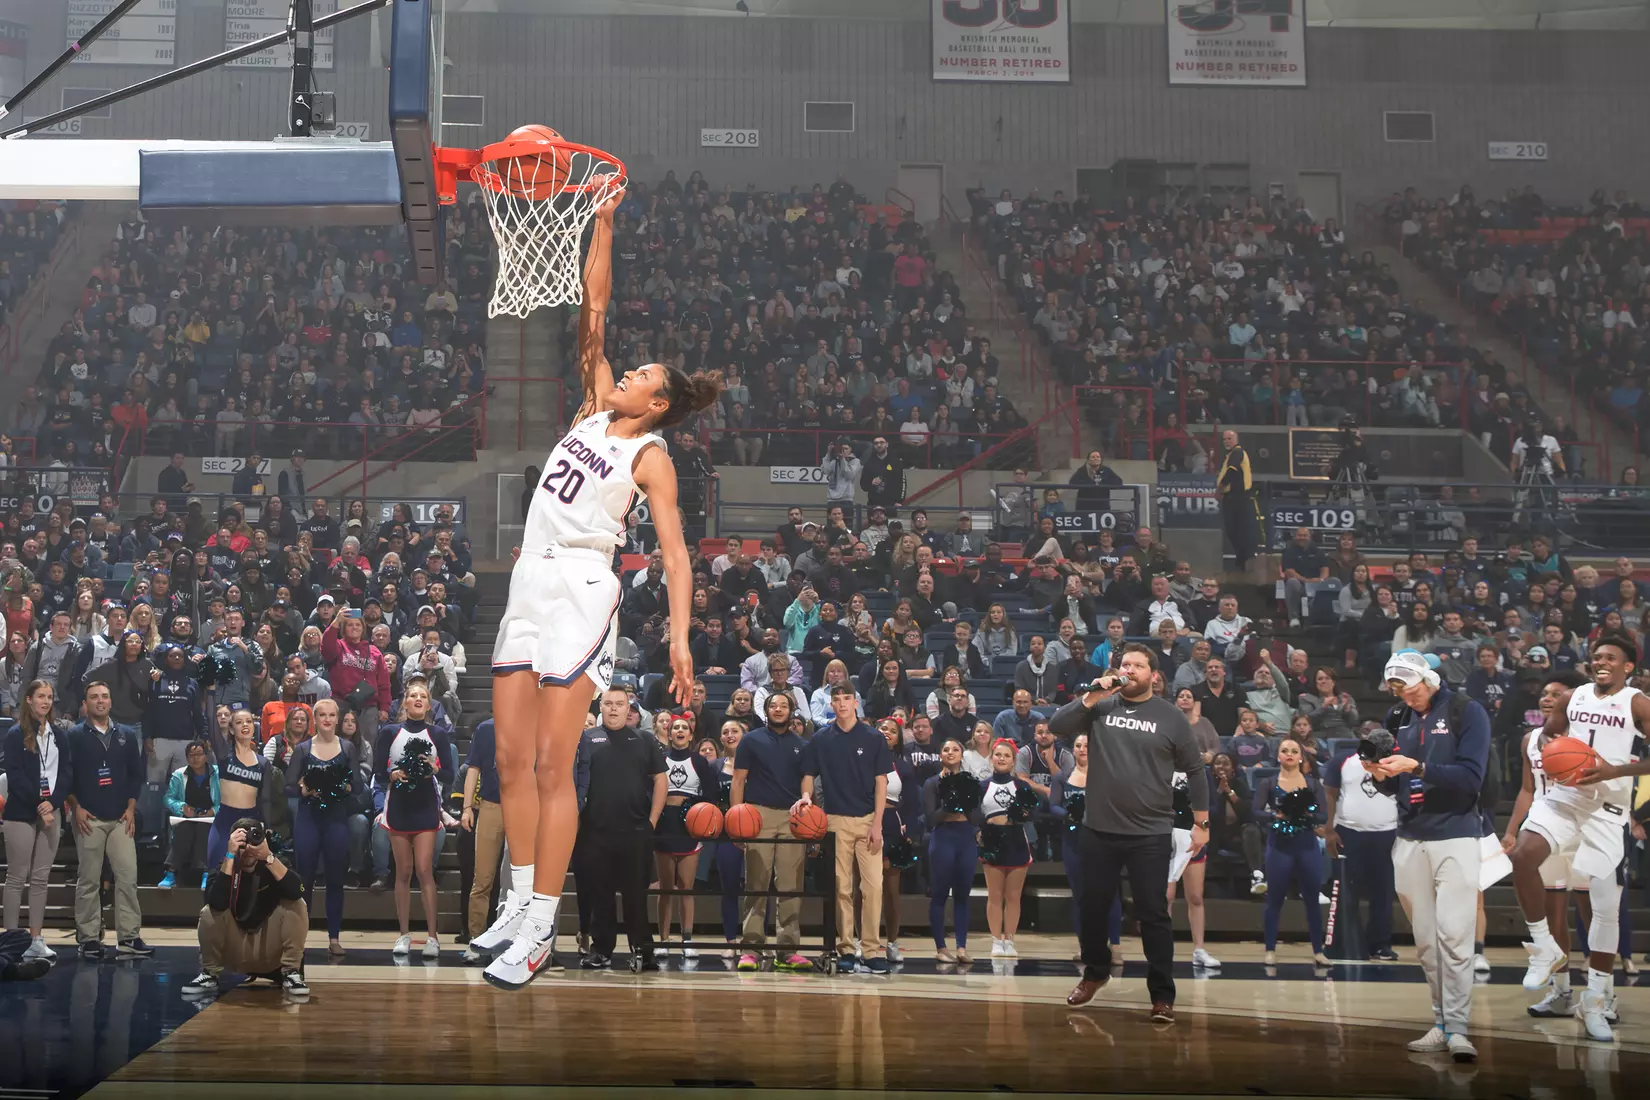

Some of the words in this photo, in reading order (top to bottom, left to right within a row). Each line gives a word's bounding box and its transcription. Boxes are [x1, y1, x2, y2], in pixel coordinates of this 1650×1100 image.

[69, 4, 116, 12] RIZZOTT
[227, 7, 265, 16] MOORE
[228, 21, 250, 30] Tina
[1000, 35, 1040, 44] MEMORIAL
[947, 45, 995, 53] BASKETBALL
[999, 45, 1017, 54] HALL
[1032, 46, 1052, 54] FAME
[939, 57, 997, 67] NUMBER
[1002, 58, 1062, 69] RETIRED
[1175, 62, 1234, 72] NUMBER
[1238, 63, 1298, 73] RETIRED
[335, 124, 369, 137] 207
[702, 134, 722, 142] SEC
[724, 132, 758, 144] 208
[1516, 144, 1546, 157] 210
[561, 434, 614, 480] UCONN
[203, 460, 227, 471] SEC
[230, 458, 270, 473] 27
[772, 469, 795, 480] SEC
[799, 467, 832, 482] 20
[541, 459, 586, 504] 20
[1056, 516, 1082, 527] SEC
[1275, 511, 1304, 523] SEC
[1309, 509, 1355, 529] 109
[1105, 714, 1158, 734] UCONN
[1569, 710, 1626, 729] UCONN
[1588, 729, 1597, 748] 1
[227, 763, 263, 780] UCONN
